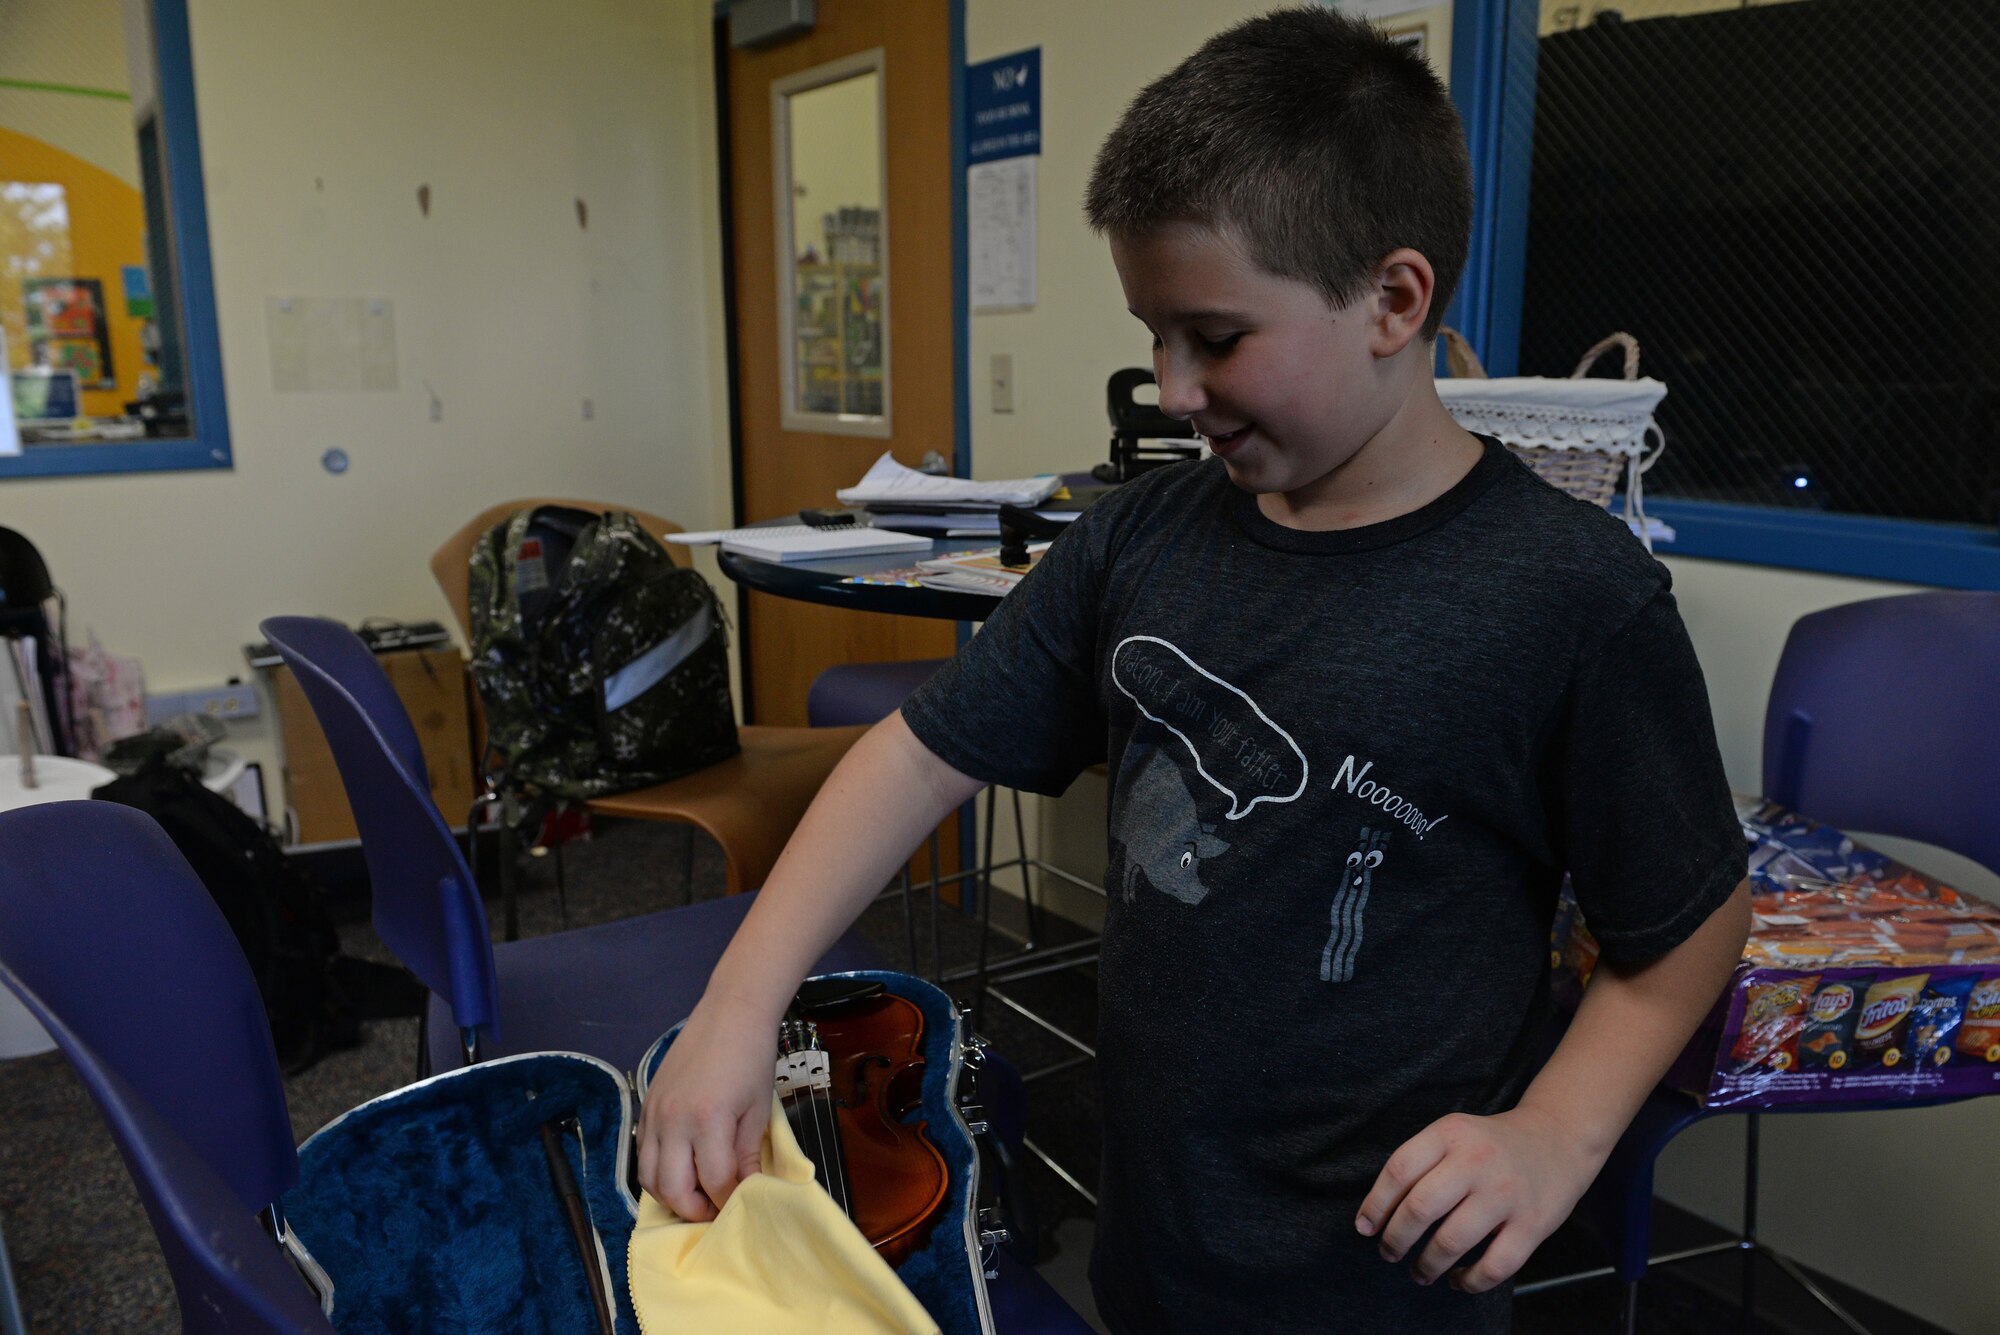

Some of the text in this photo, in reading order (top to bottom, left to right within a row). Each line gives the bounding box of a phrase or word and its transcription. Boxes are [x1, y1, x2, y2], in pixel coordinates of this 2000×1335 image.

[1160, 678, 1181, 703] I
[1176, 691, 1206, 720] am
[1235, 737, 1287, 789] father
[1861, 997, 1906, 1027] Fritos
